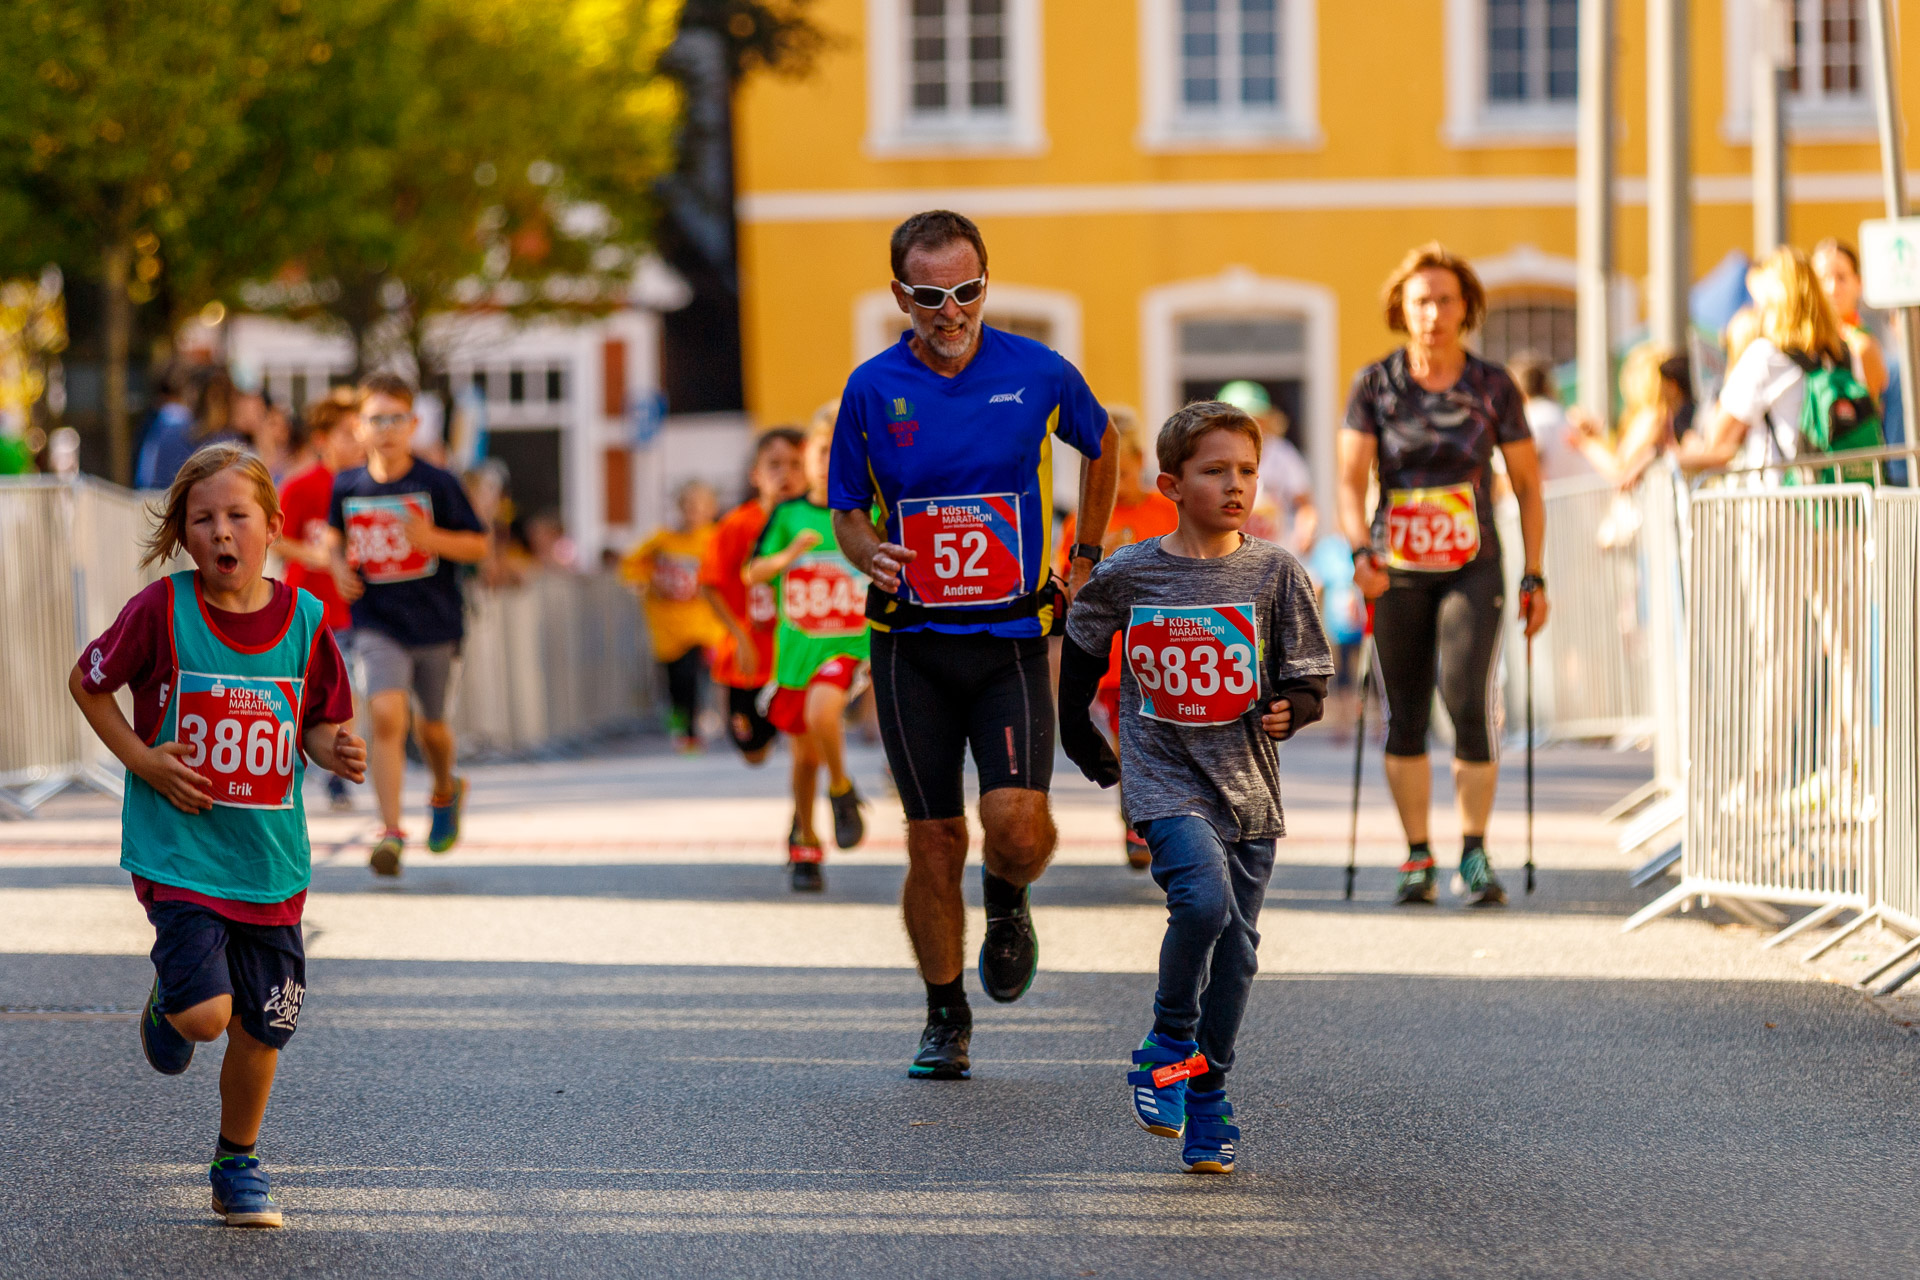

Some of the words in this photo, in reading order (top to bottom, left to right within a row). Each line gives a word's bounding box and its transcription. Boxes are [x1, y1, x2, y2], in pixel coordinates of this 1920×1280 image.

[941, 505, 980, 516] KÜSTEN
[942, 513, 992, 524] MARATHON
[1391, 511, 1476, 554] 7525
[934, 530, 989, 579] 52
[943, 584, 983, 597] Andrew
[1169, 616, 1211, 627] KÜSTEN
[1169, 626, 1225, 637] MARATHON
[1131, 643, 1254, 696] 3833
[229, 687, 271, 700] KÜSTEN
[229, 699, 282, 711] MARATHON
[1178, 703, 1206, 715] Felix
[181, 714, 295, 776] 3860
[228, 781, 252, 797] Erik
